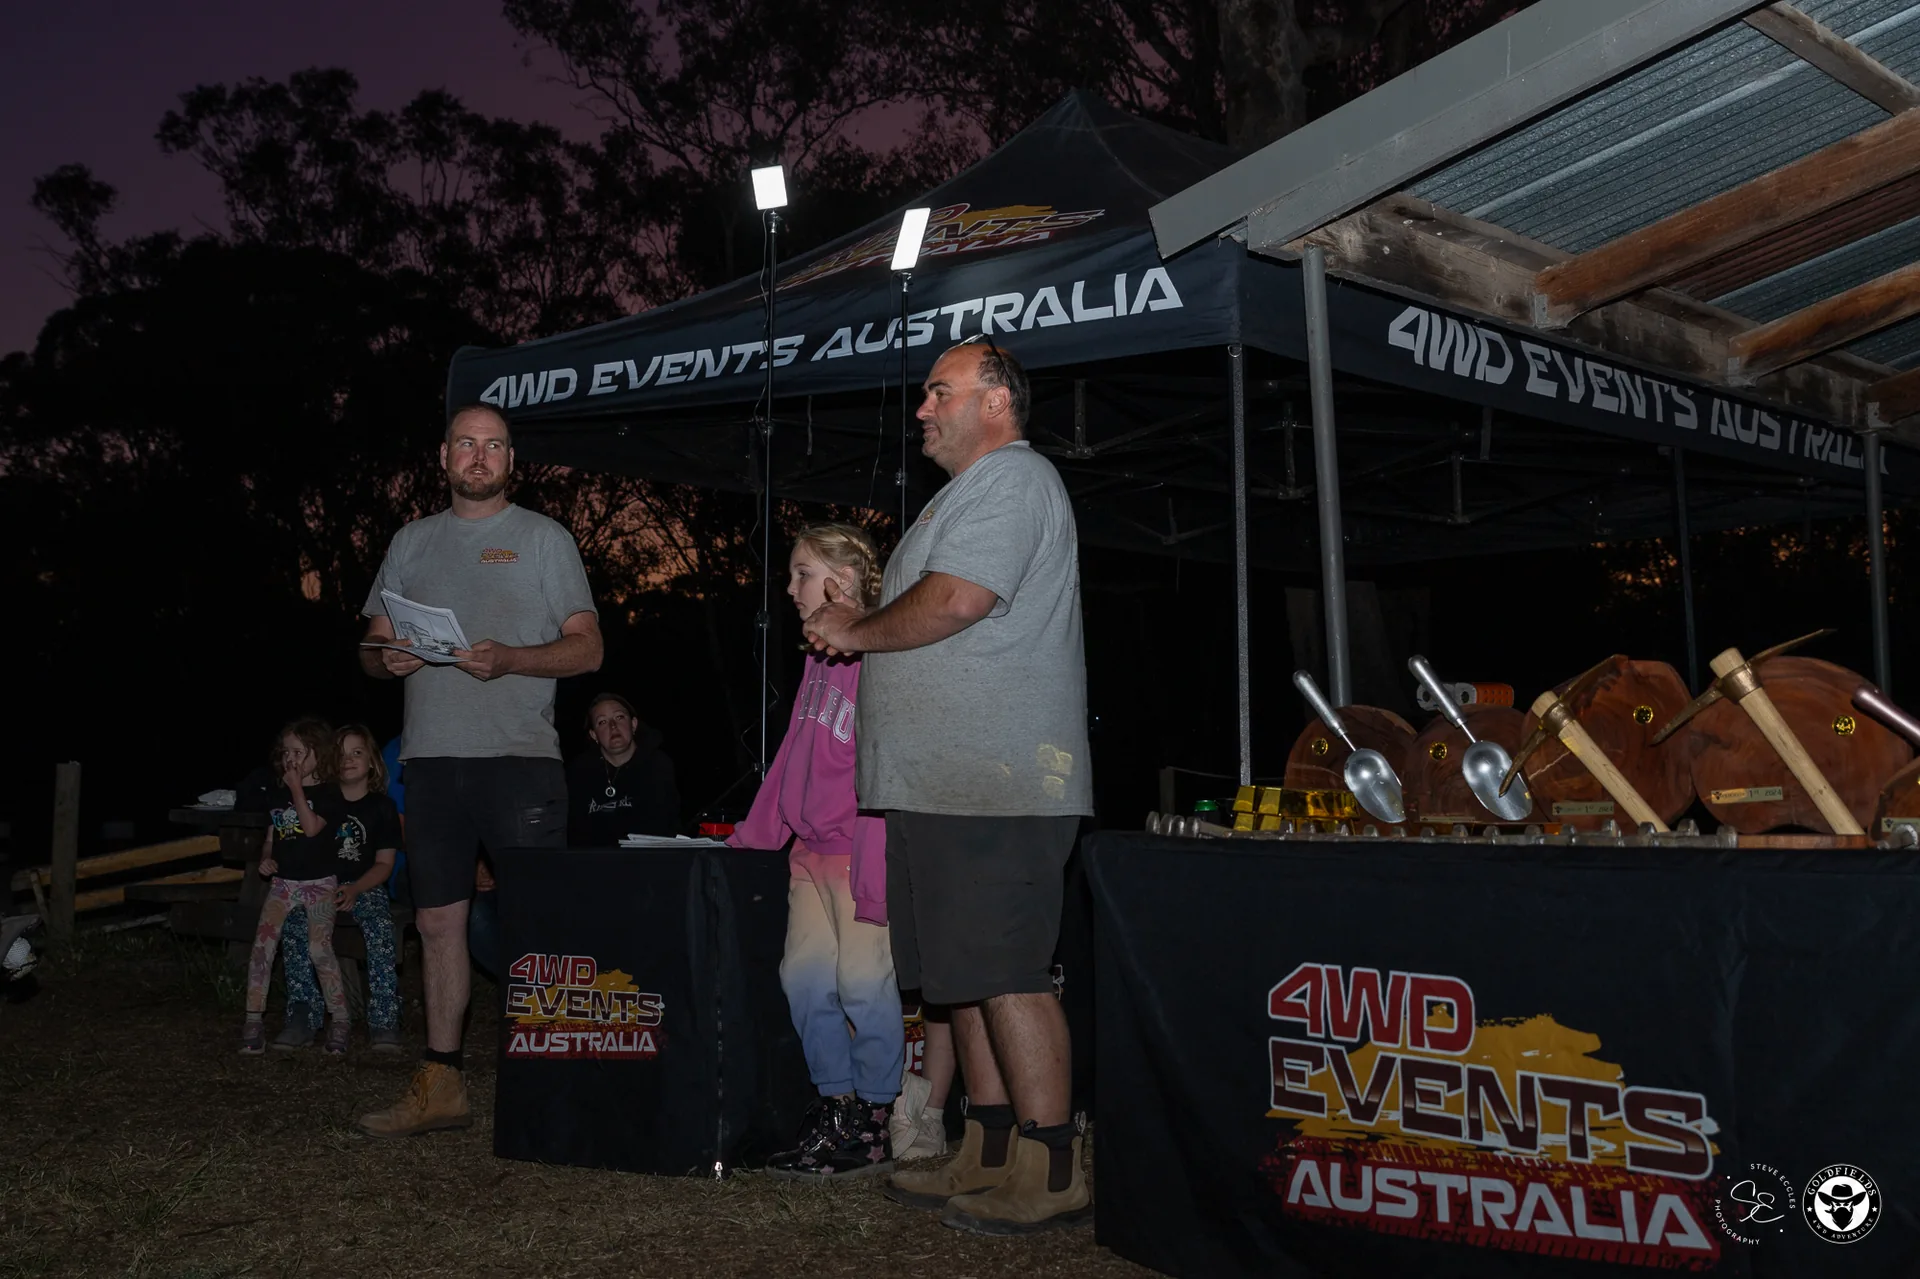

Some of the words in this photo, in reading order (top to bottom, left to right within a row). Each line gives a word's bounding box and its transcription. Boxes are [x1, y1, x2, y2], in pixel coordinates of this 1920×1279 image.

[479, 367, 577, 409] 4WD
[587, 334, 805, 396] EVENTS
[810, 266, 1184, 361] AUSTRALIA
[1388, 305, 1514, 385] 4WD
[1520, 340, 1699, 430] EVENTS
[1710, 397, 1890, 475] AUSTRAL
[506, 984, 662, 1026] EVENTS
[509, 953, 597, 987] 4WD
[1268, 962, 1476, 1056] 4WD
[508, 1031, 656, 1053] AUSTRALIA
[1269, 1037, 1714, 1181] EVENTS
[1286, 1159, 1713, 1250] AUSTRALIA
